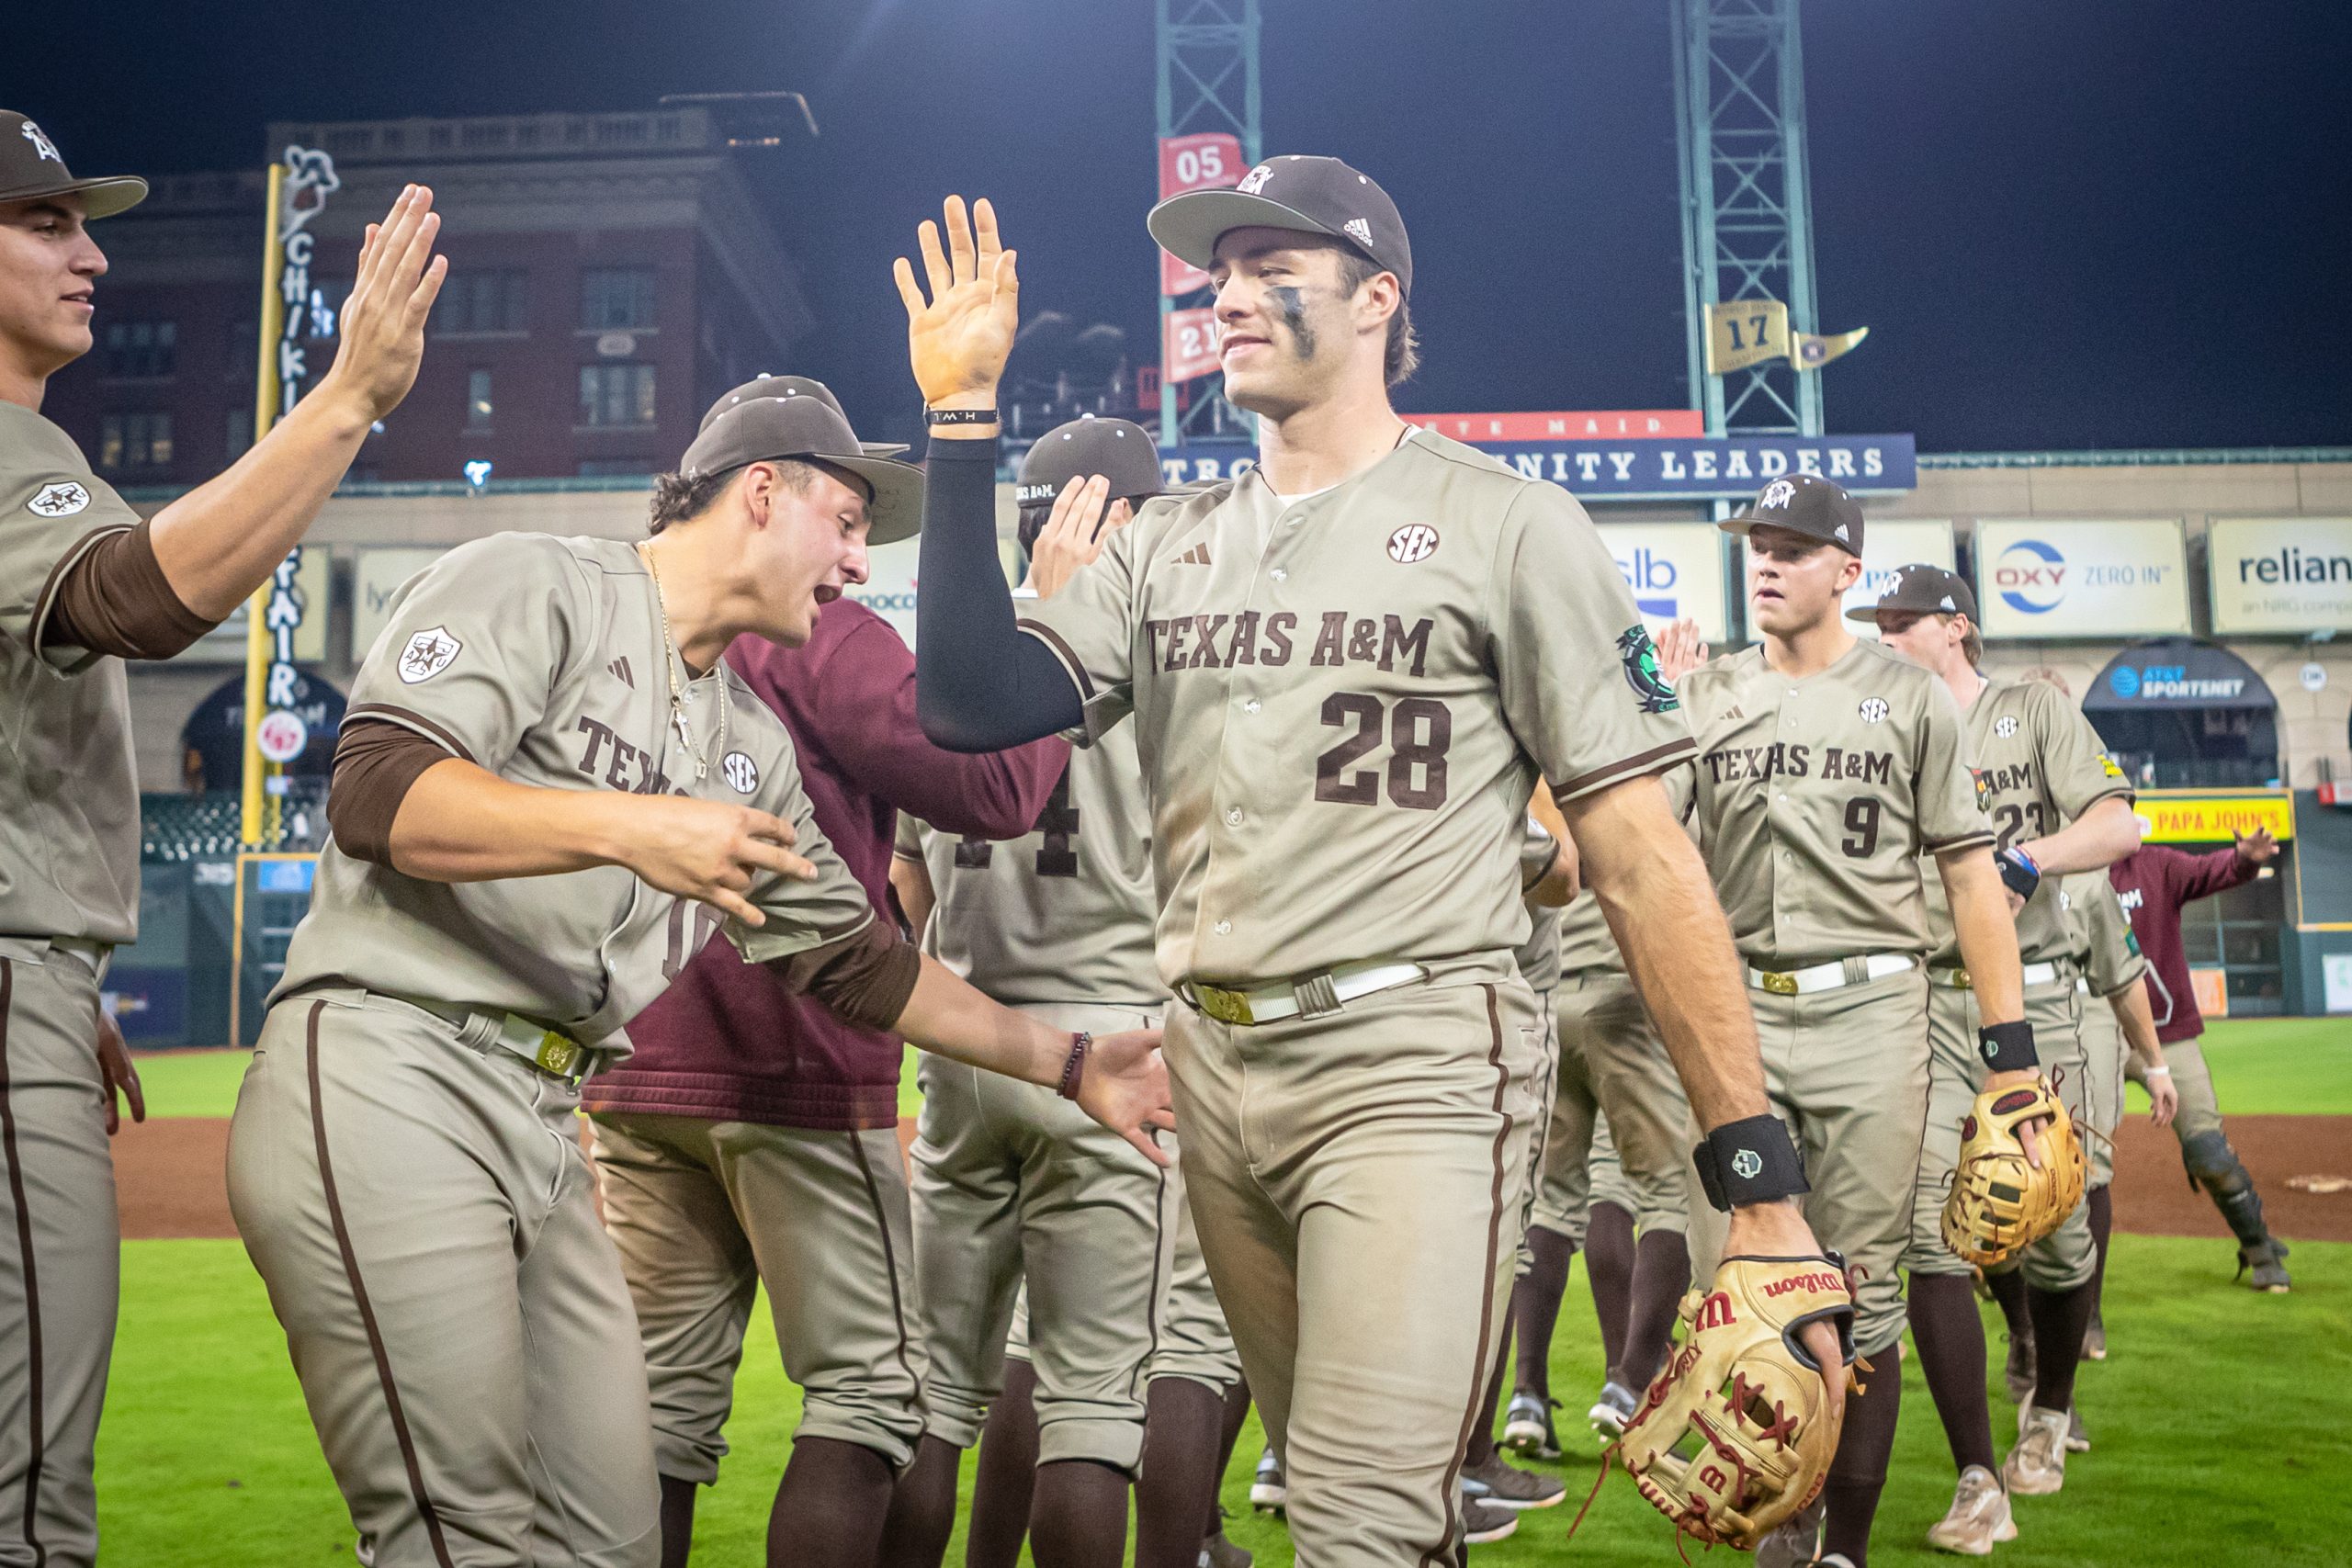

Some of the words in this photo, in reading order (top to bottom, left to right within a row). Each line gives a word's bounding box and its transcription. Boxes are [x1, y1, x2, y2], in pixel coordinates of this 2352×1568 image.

[1176, 147, 1223, 183] 05
[1343, 223, 1374, 248] adidas
[280, 232, 313, 424] CHIKI
[1727, 315, 1769, 351] 17
[1548, 417, 1661, 434] MAID
[1497, 453, 1634, 480] NITY
[1660, 447, 1883, 479] LEADERS
[1388, 525, 1438, 562] SEC
[1996, 568, 2065, 585] OXY
[2085, 566, 2134, 585] ZERO
[2239, 547, 2352, 583] relian
[1146, 610, 1297, 675] TEXAS
[1310, 611, 1434, 677] A&M
[1860, 697, 1889, 723] SEC
[1995, 716, 2018, 739] SEC
[578, 715, 690, 796] TEX
[1315, 692, 1452, 810] 28
[1702, 742, 1810, 784] TEXAS
[1821, 748, 1894, 785] A&M
[723, 750, 759, 794] SEC
[1981, 762, 2033, 795] A&M
[1841, 796, 1881, 858] 9
[2158, 812, 2205, 830] PAPA
[2212, 810, 2279, 831] JOHN'S
[1763, 1272, 1846, 1298] Wilson
